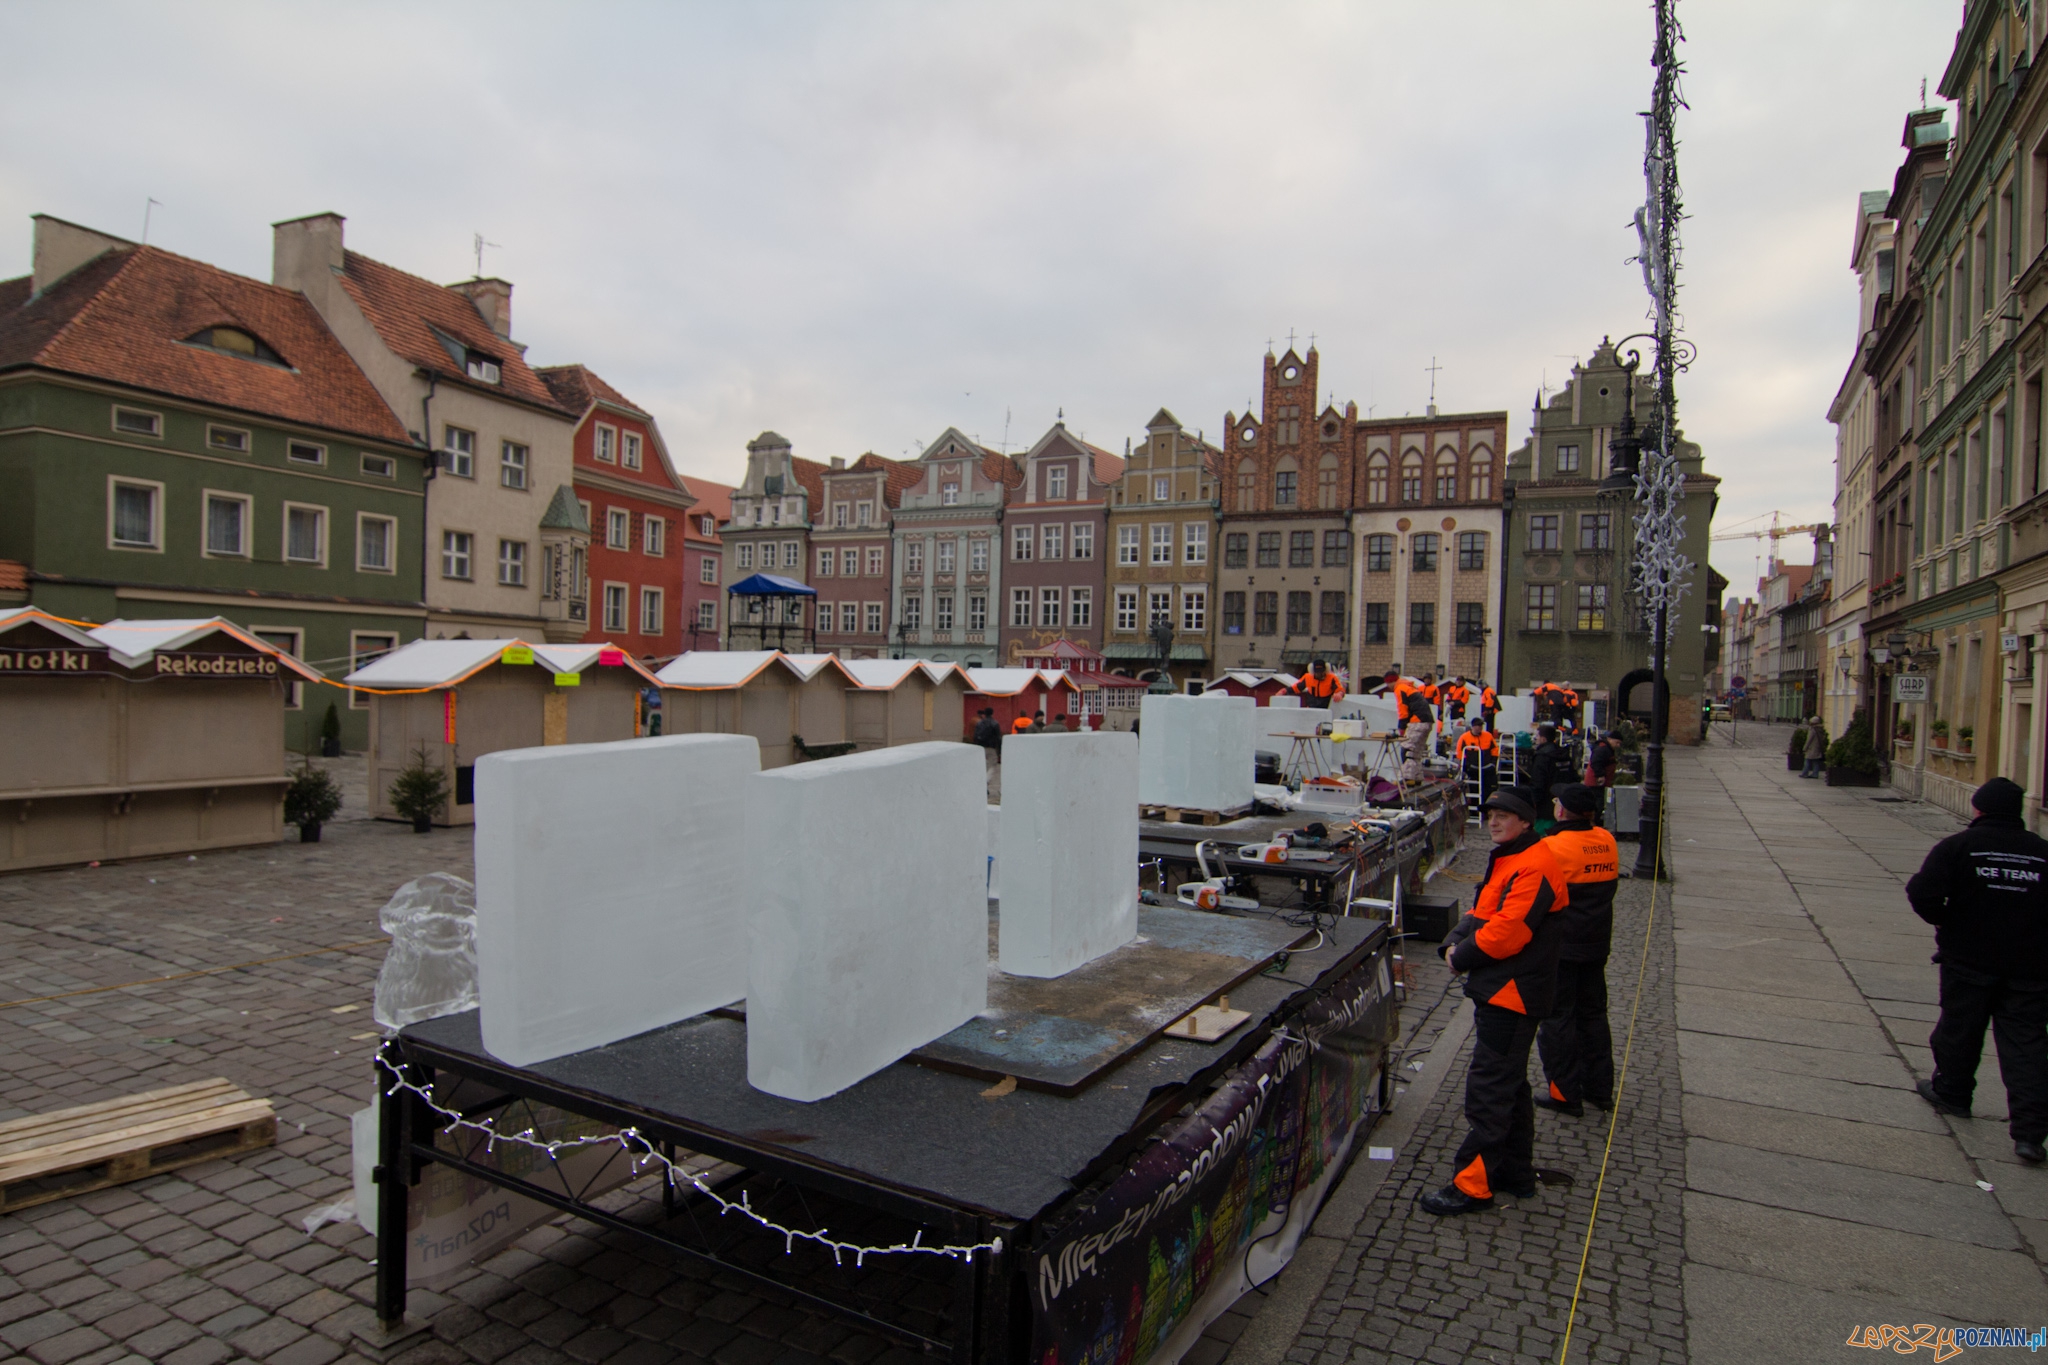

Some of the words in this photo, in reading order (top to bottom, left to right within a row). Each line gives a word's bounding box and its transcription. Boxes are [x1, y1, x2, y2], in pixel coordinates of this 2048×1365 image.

[156, 654, 278, 676] Rękodzieło
[1899, 678, 1924, 690] SARP
[1582, 844, 1610, 854] RUSSIA
[1583, 862, 1614, 873] STIHL
[1975, 866, 1999, 878] ICE
[2001, 868, 2041, 881] TEAM
